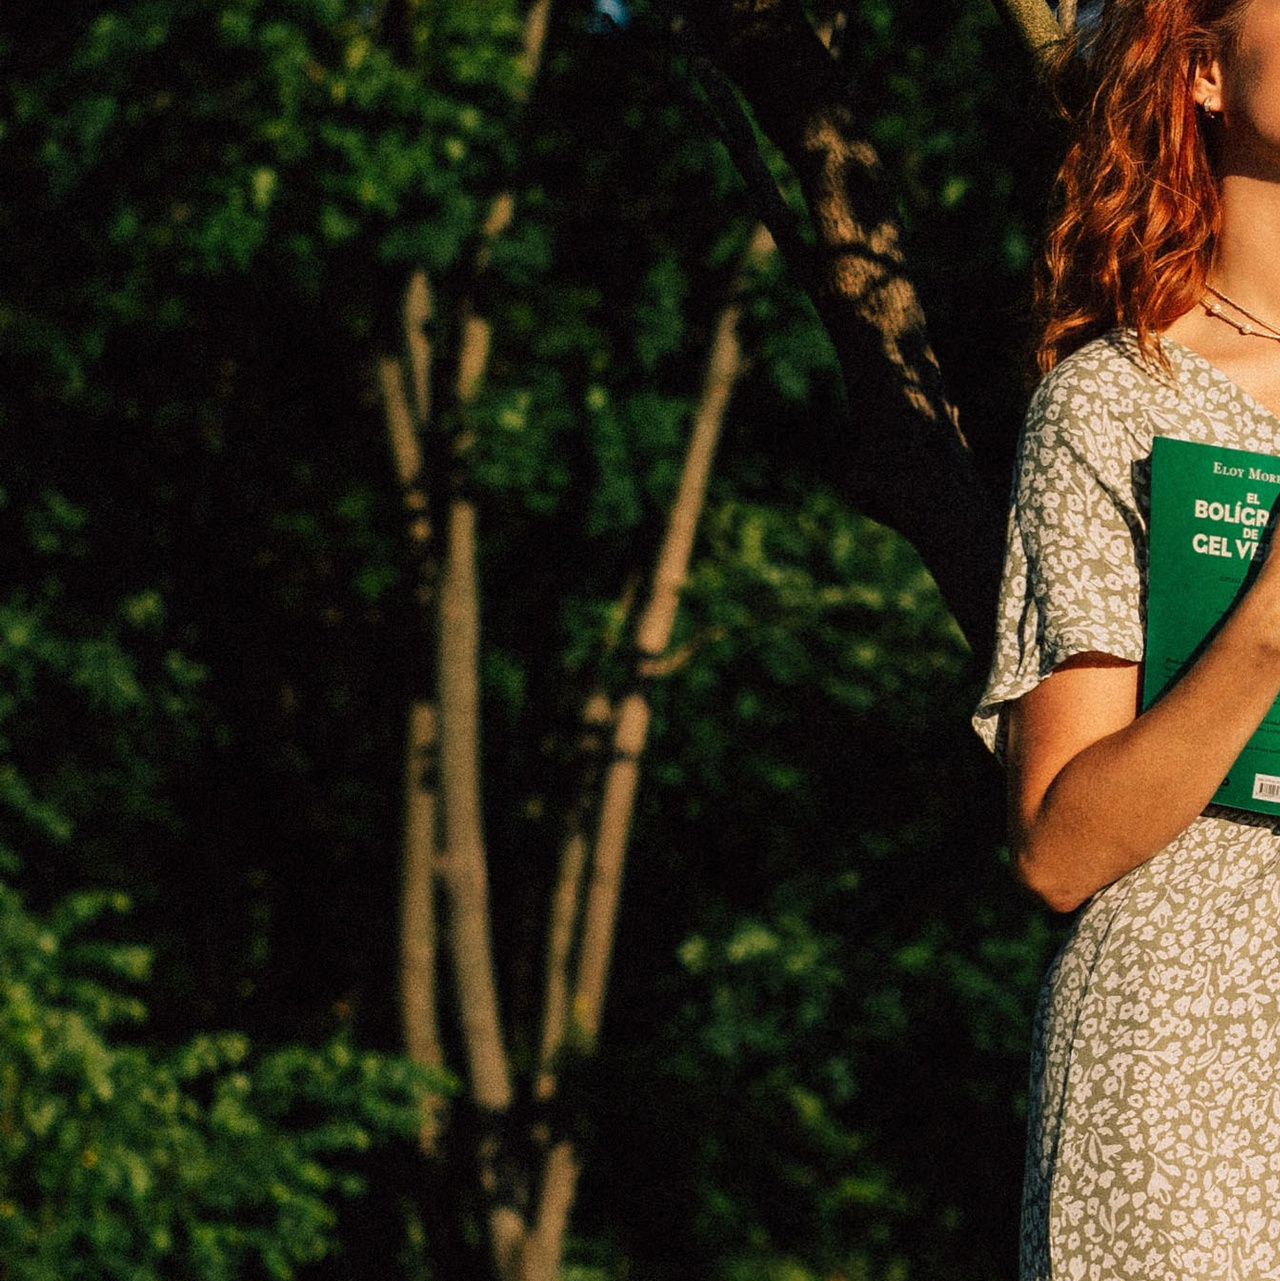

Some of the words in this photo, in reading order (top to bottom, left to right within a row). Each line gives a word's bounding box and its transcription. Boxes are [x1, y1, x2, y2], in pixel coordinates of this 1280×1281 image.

[1213, 461, 1245, 478] ELOY
[1246, 492, 1260, 505] EL
[1194, 499, 1270, 527] BOLÍGR
[1242, 527, 1259, 540] DE
[1192, 533, 1233, 558] GEL
[1235, 539, 1264, 562] VE
